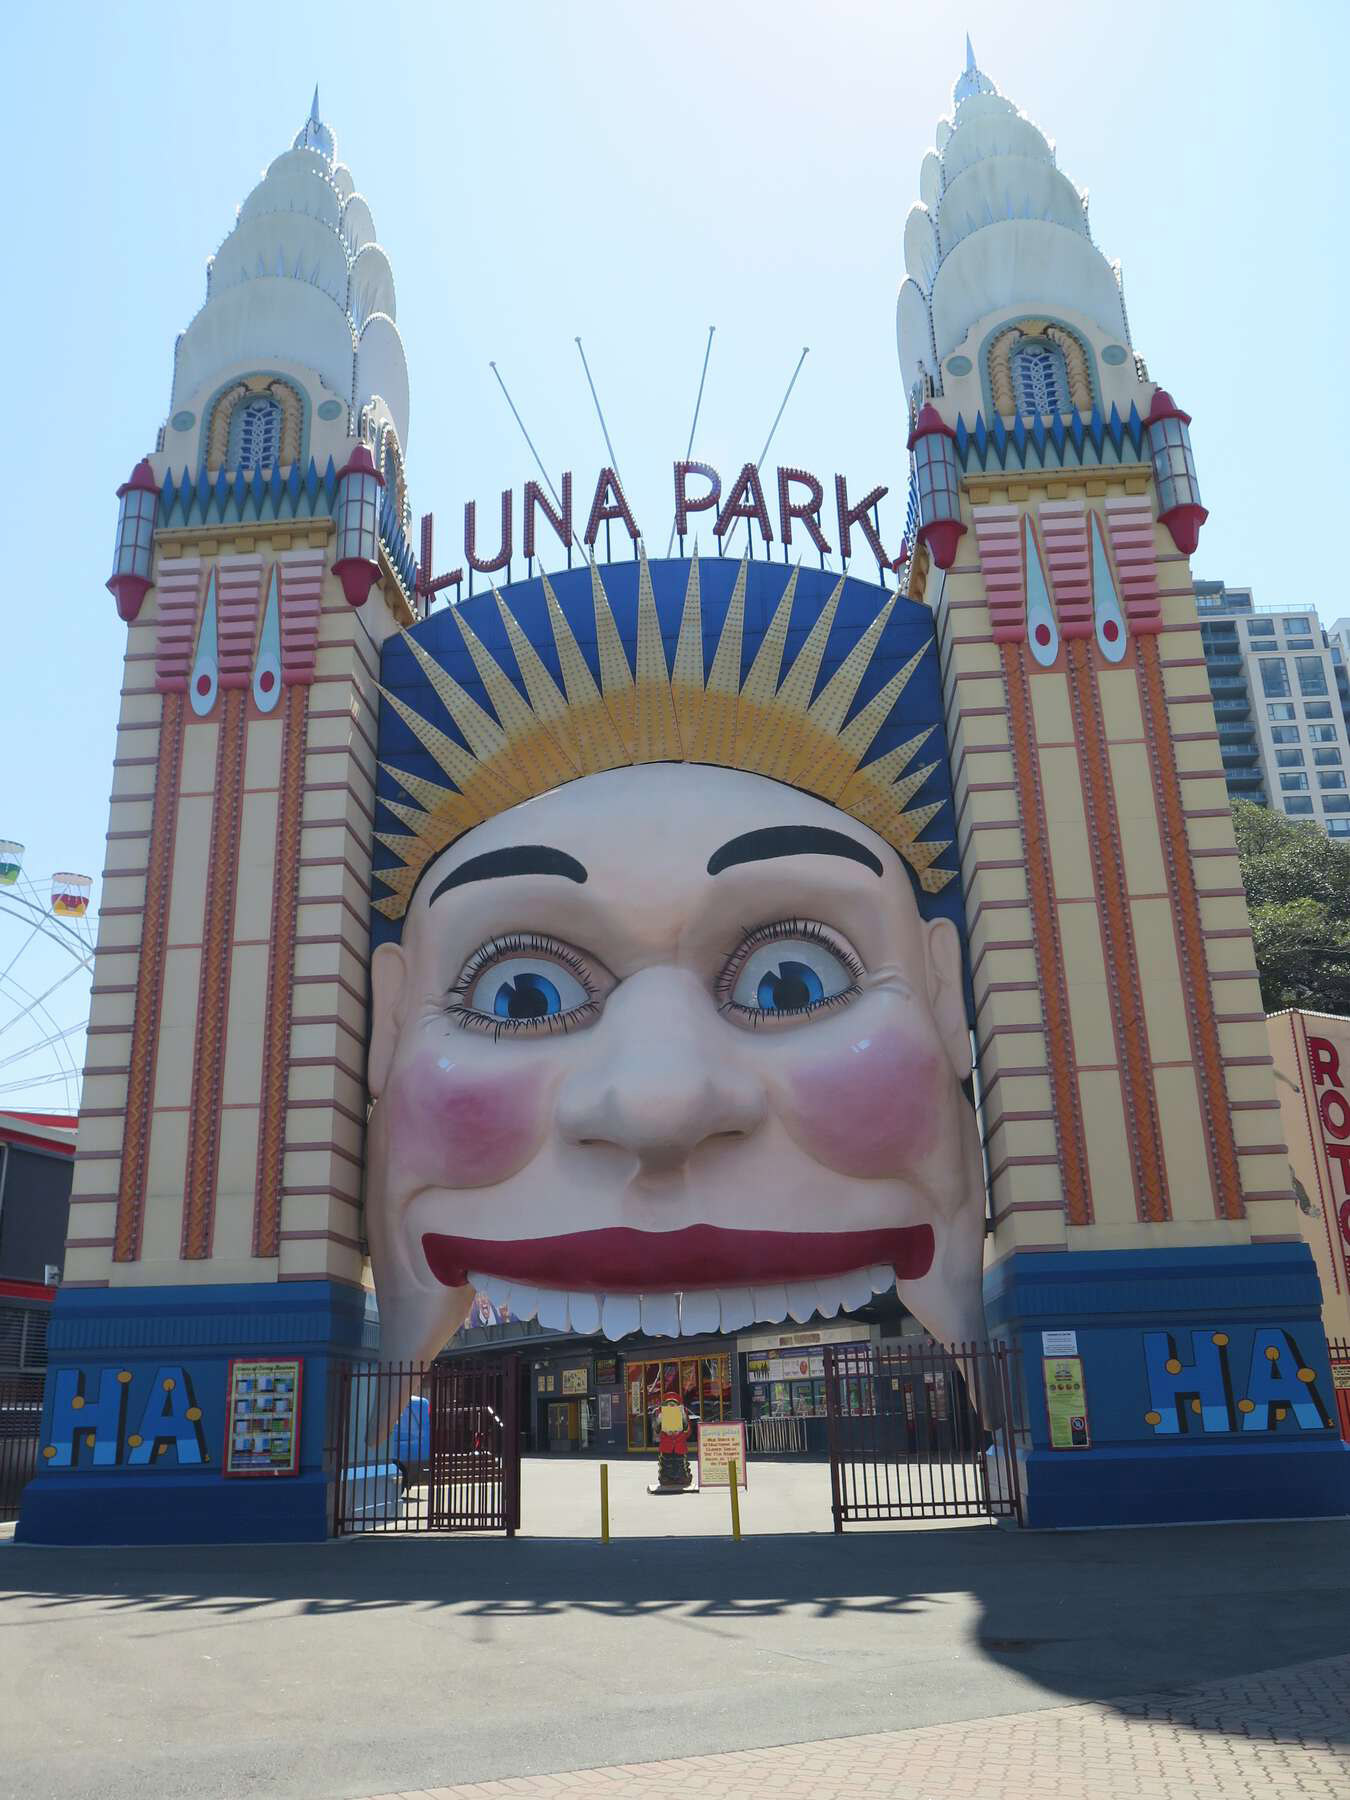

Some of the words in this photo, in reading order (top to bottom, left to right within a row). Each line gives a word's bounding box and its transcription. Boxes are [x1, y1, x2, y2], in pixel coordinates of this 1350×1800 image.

[416, 467, 641, 597] LUNA
[673, 461, 893, 569] PARK
[46, 1366, 206, 1466] HA
[1143, 1328, 1329, 1434] HA
